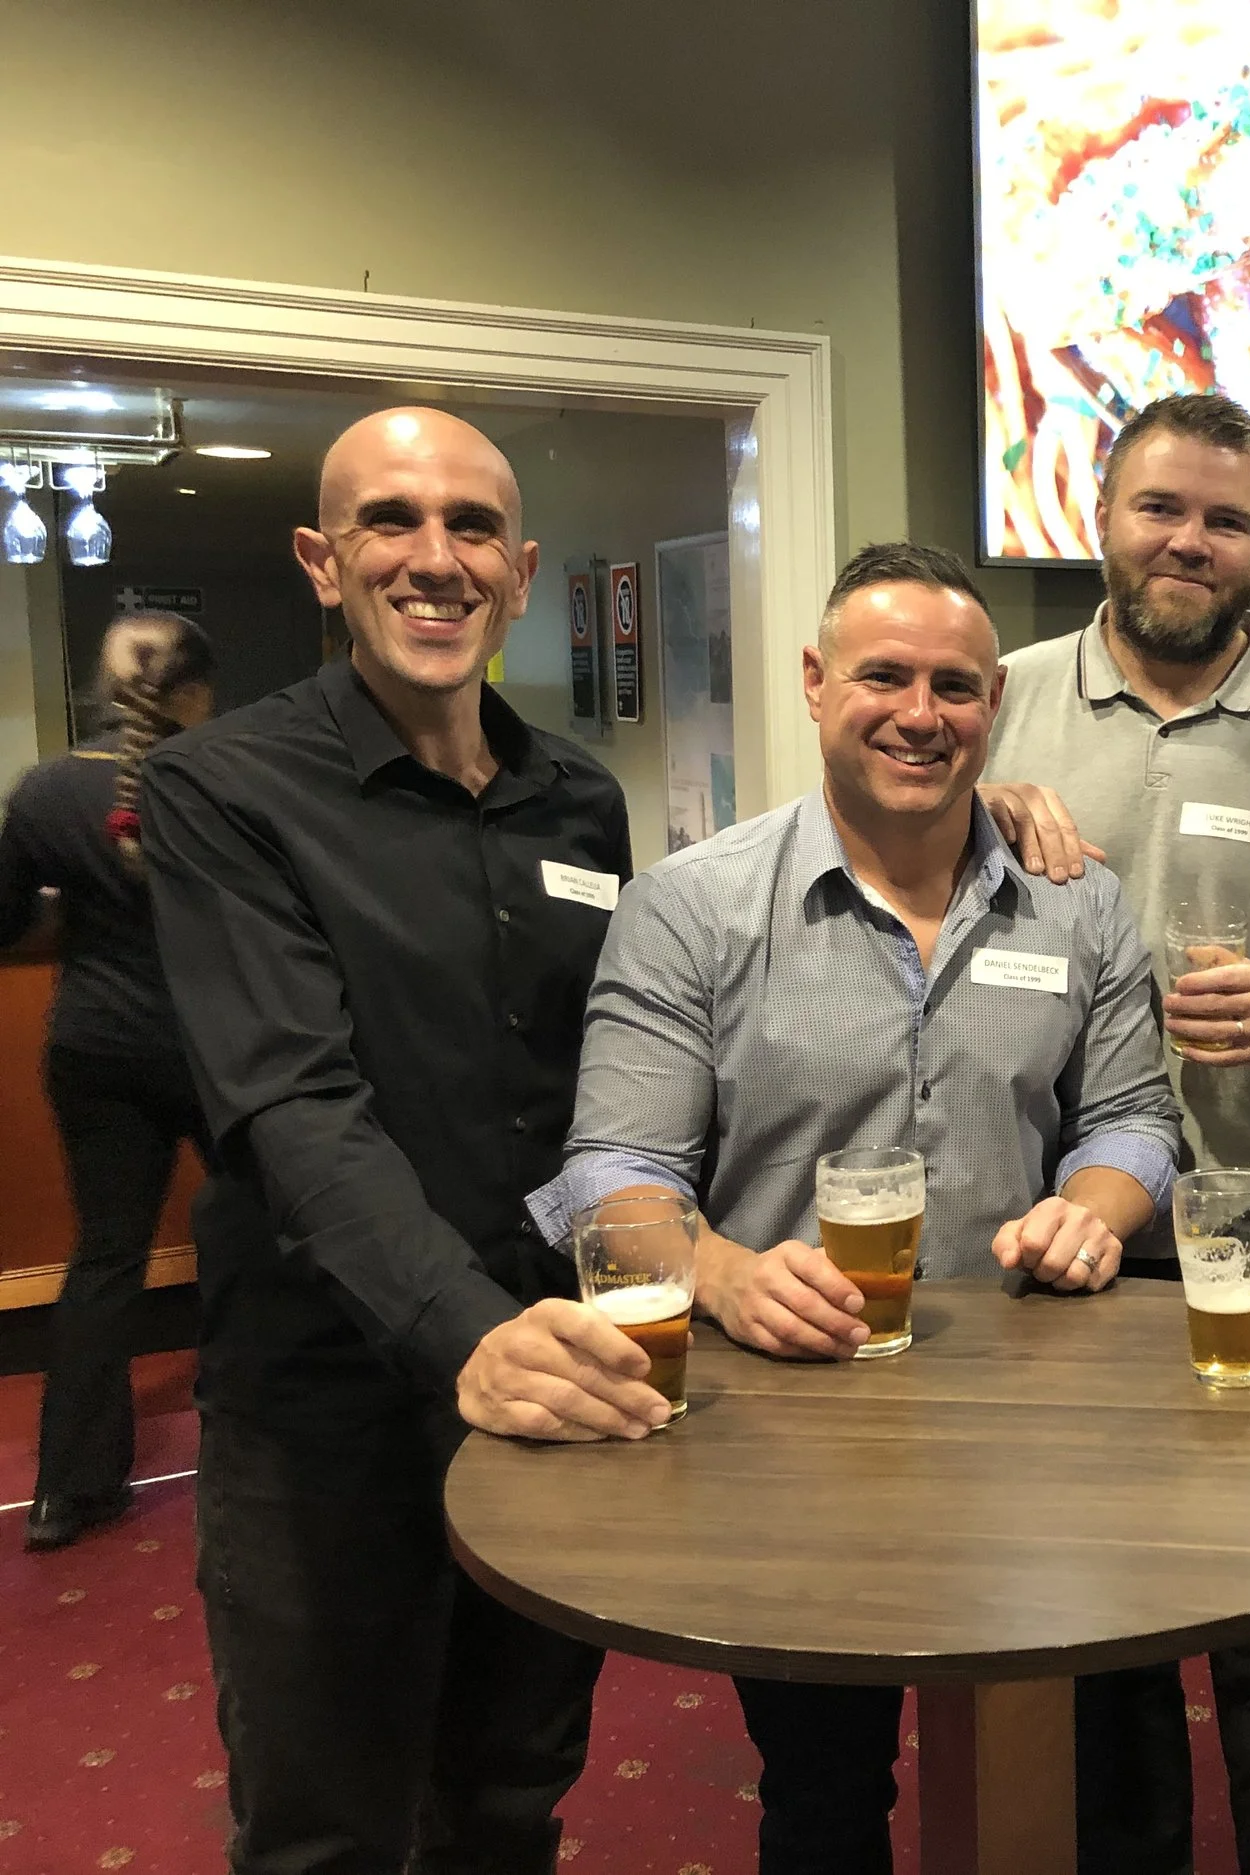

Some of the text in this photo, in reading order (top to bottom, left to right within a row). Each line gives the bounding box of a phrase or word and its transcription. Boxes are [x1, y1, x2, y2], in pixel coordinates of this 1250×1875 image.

[984, 959, 1060, 975] DANIEL SENDELBECK
[1003, 973, 1019, 981] Class
